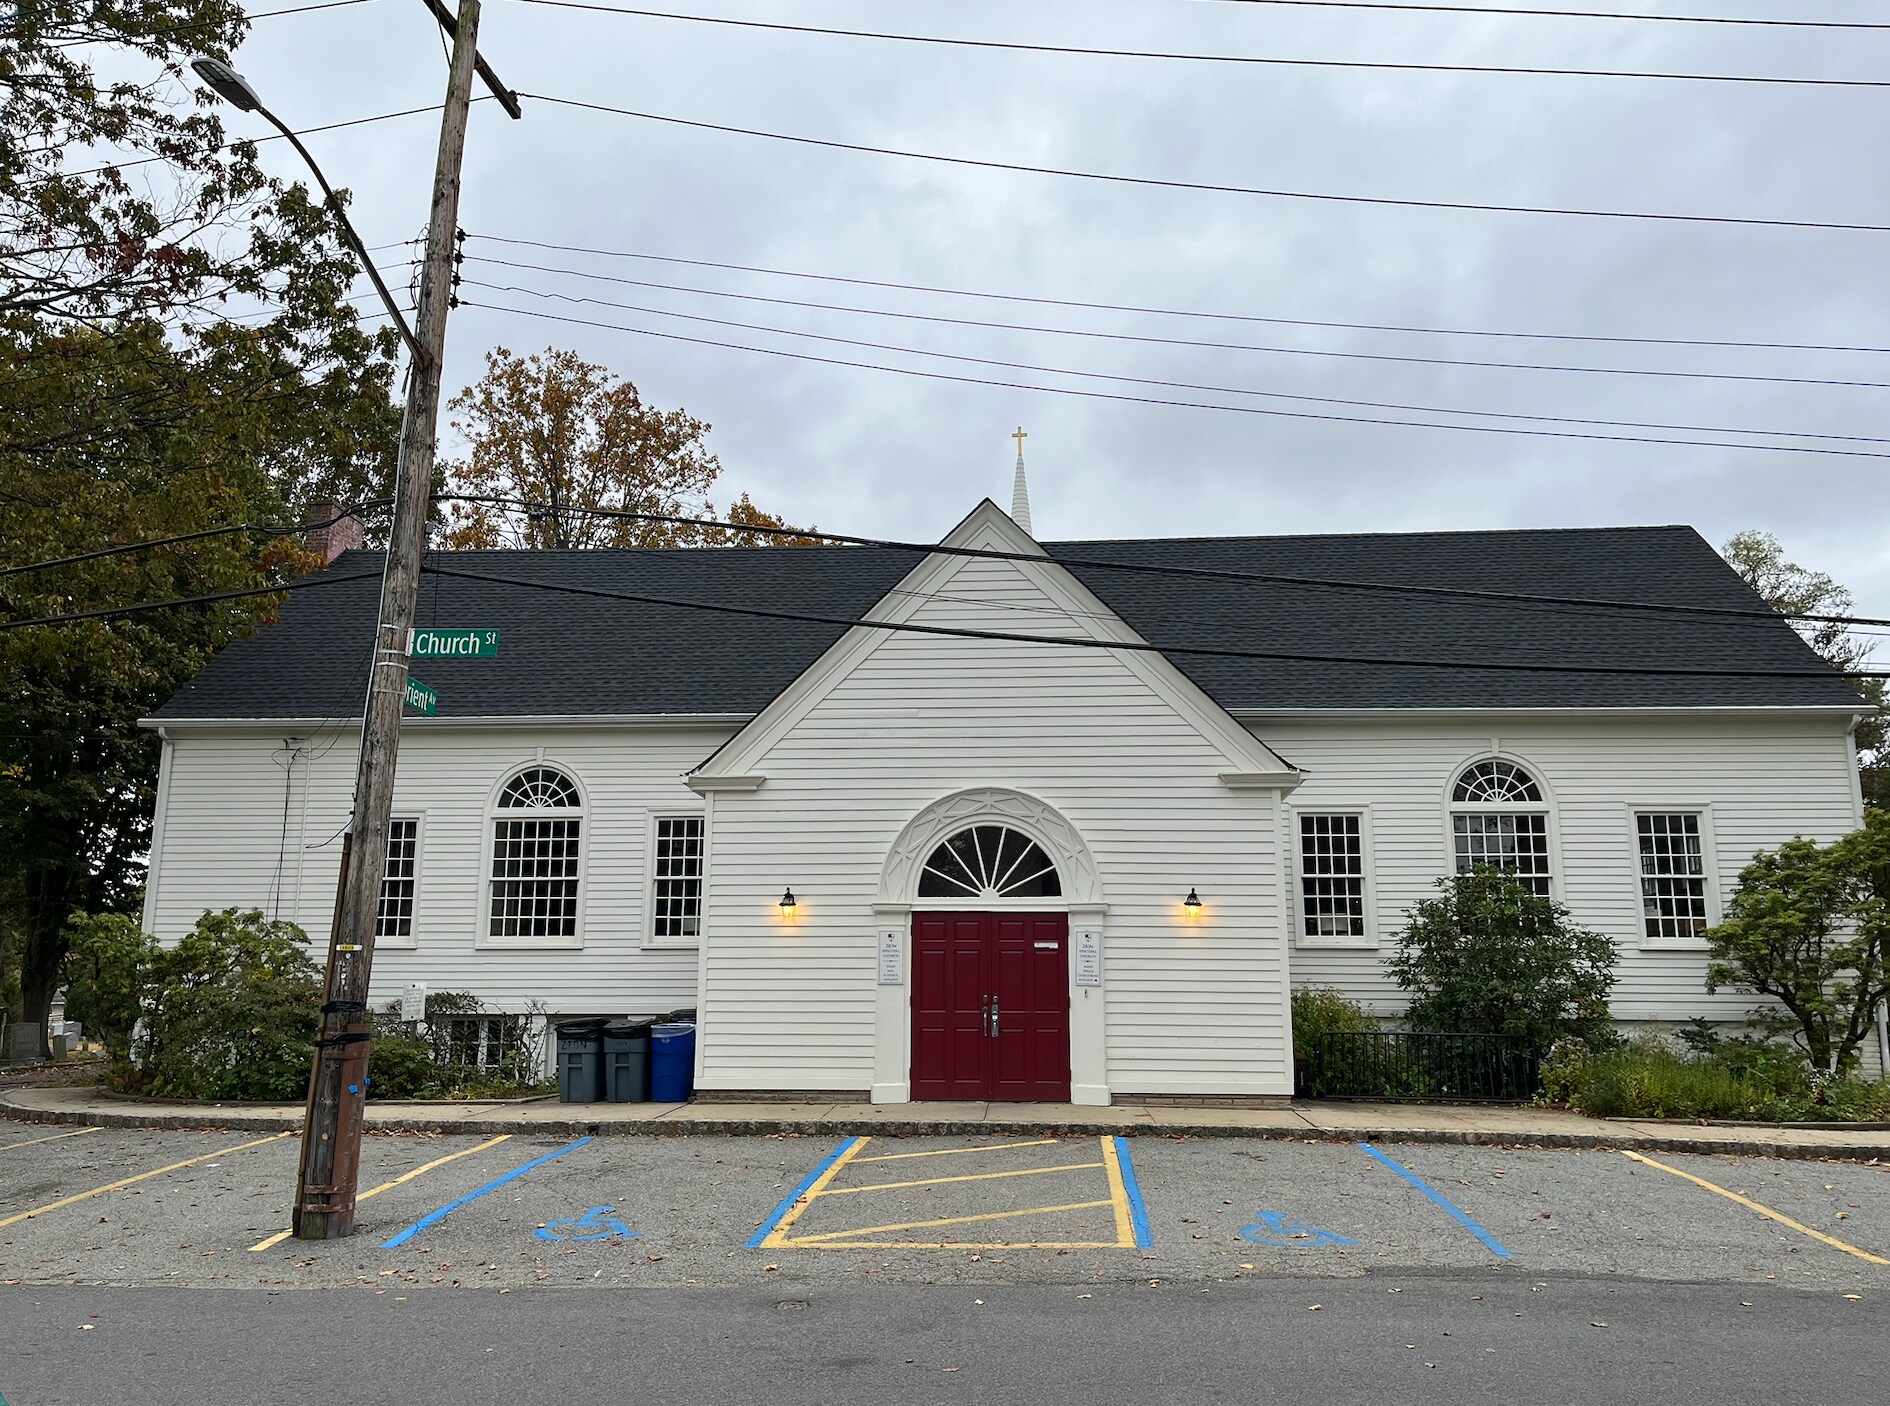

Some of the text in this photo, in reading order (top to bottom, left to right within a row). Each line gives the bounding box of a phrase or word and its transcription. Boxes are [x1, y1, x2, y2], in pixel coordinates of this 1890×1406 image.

[416, 631, 497, 654] Church St
[405, 682, 429, 711] rient
[561, 1040, 587, 1050] ZION
